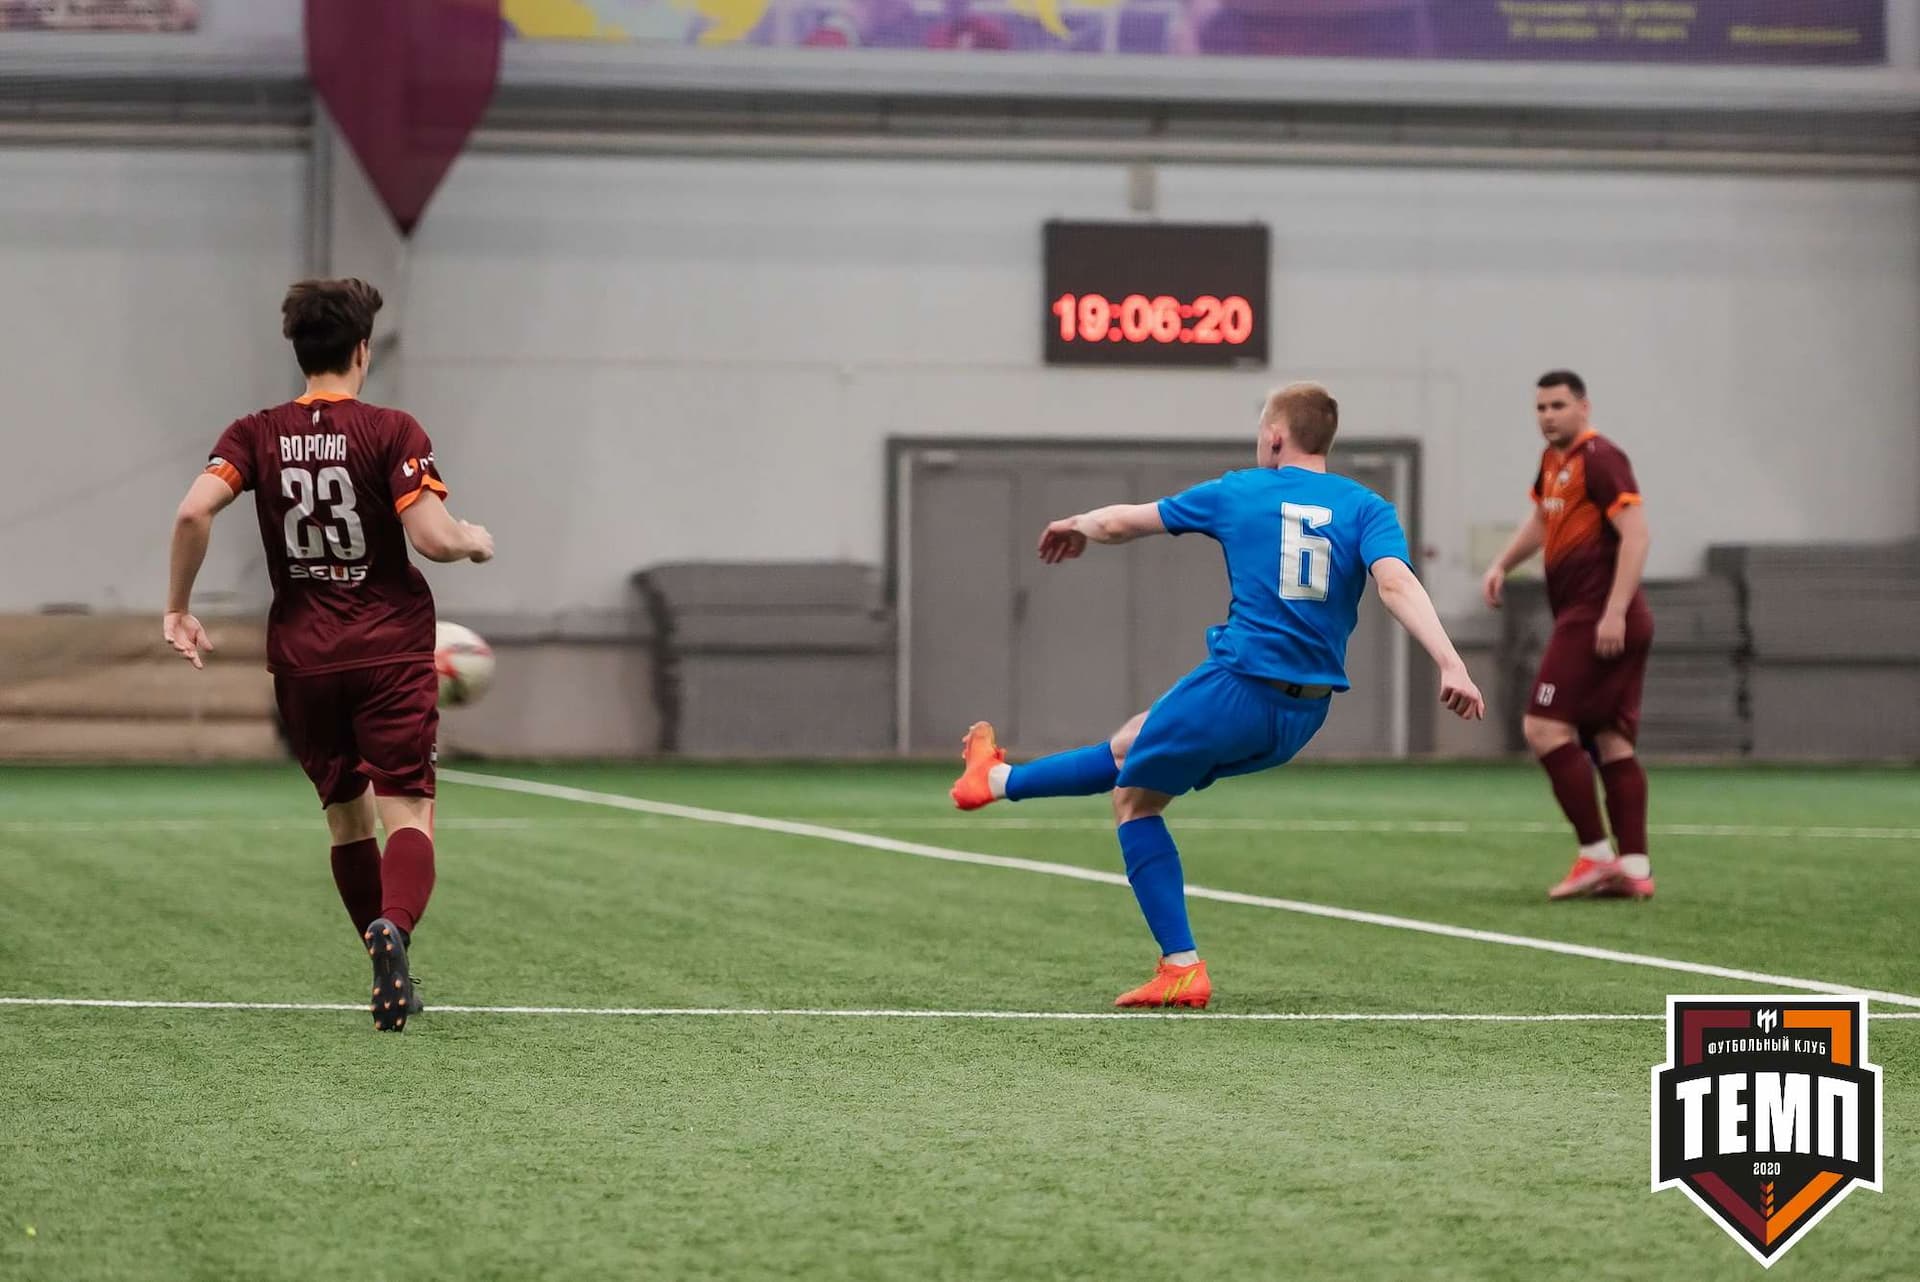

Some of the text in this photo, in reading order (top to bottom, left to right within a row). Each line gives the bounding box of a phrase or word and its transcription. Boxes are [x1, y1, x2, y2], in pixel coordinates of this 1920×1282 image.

[1052, 292, 1253, 345] 19:06:20
[280, 434, 347, 462] ВОРОНА
[281, 467, 367, 560] 23
[1279, 502, 1333, 602] 6
